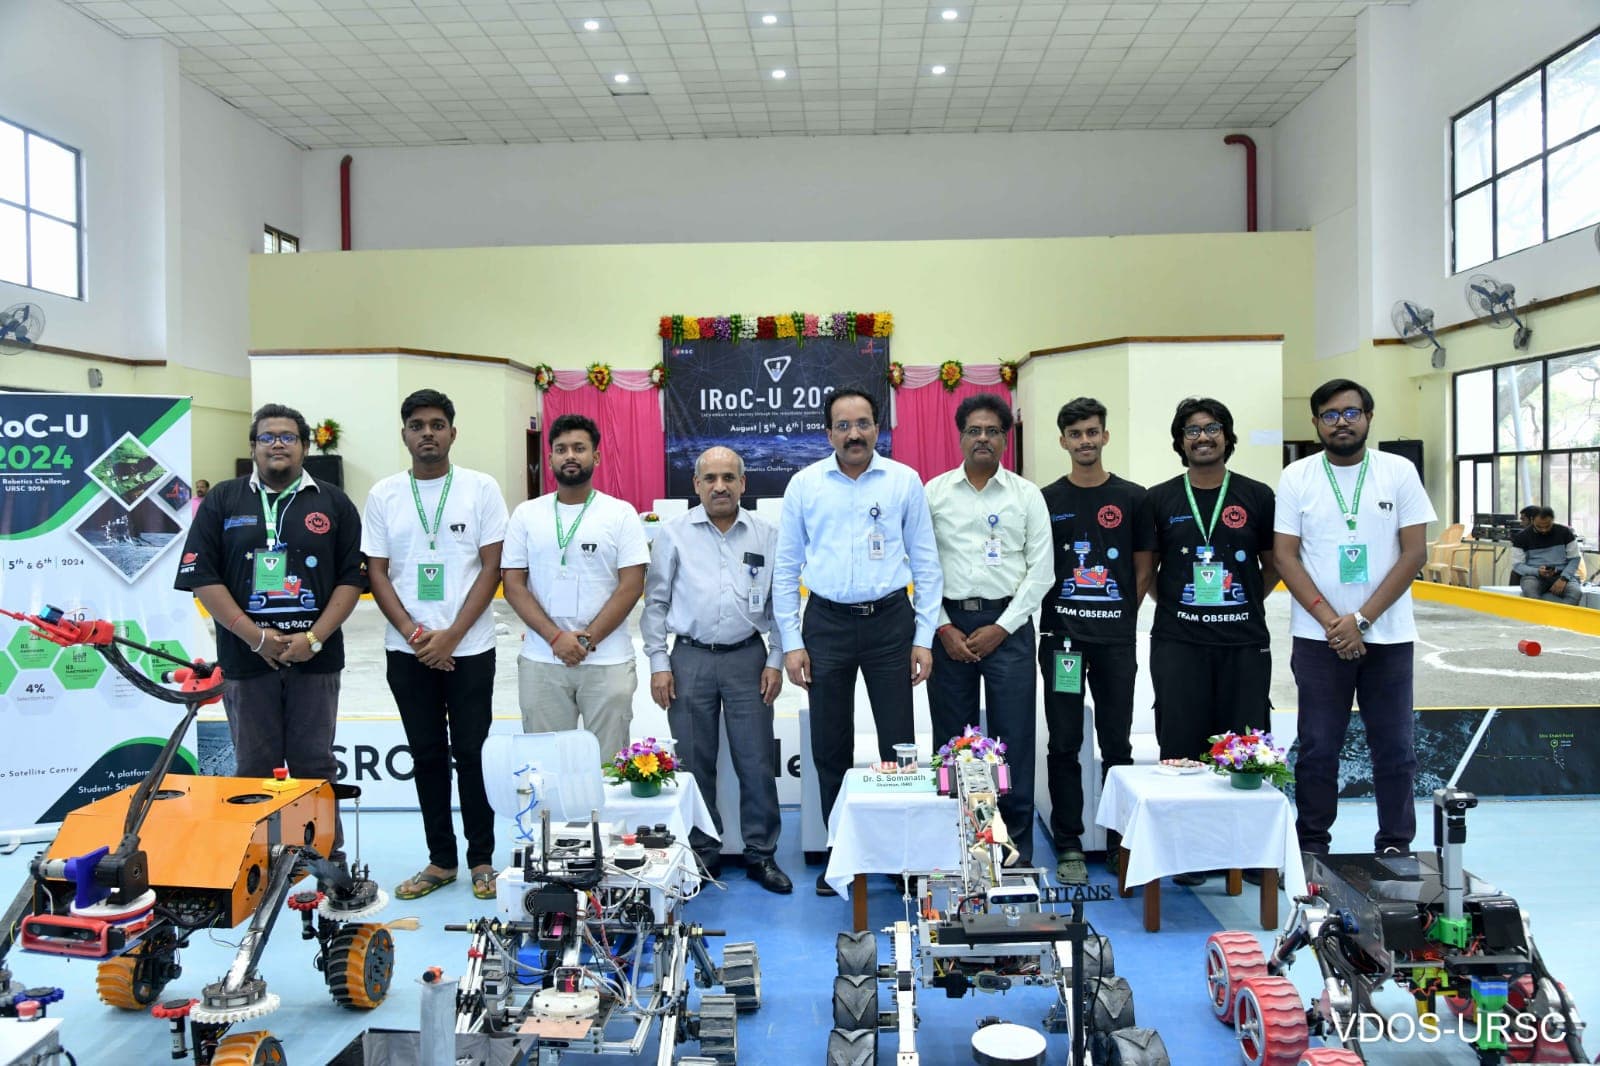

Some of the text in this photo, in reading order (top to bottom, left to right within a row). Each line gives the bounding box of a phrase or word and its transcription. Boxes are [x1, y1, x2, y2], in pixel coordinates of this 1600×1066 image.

[700, 386, 835, 411] IRoC-U 20
[0, 413, 89, 439] oC-U
[730, 423, 757, 433] August
[766, 465, 793, 473] Challenge
[34, 477, 71, 486] Challenge
[8, 556, 24, 570] 5th
[35, 556, 52, 569] 6th
[61, 558, 84, 566] 2024
[1078, 609, 1122, 619] OBSERACT
[1201, 611, 1249, 623] OBSERACT
[25, 682, 46, 694] 4%
[332, 744, 415, 781] SRO
[9, 768, 46, 777] Satellite
[863, 774, 926, 783] Dr. S. Somanath
[78, 784, 113, 794] Student-
[1041, 884, 1112, 902] TITANS
